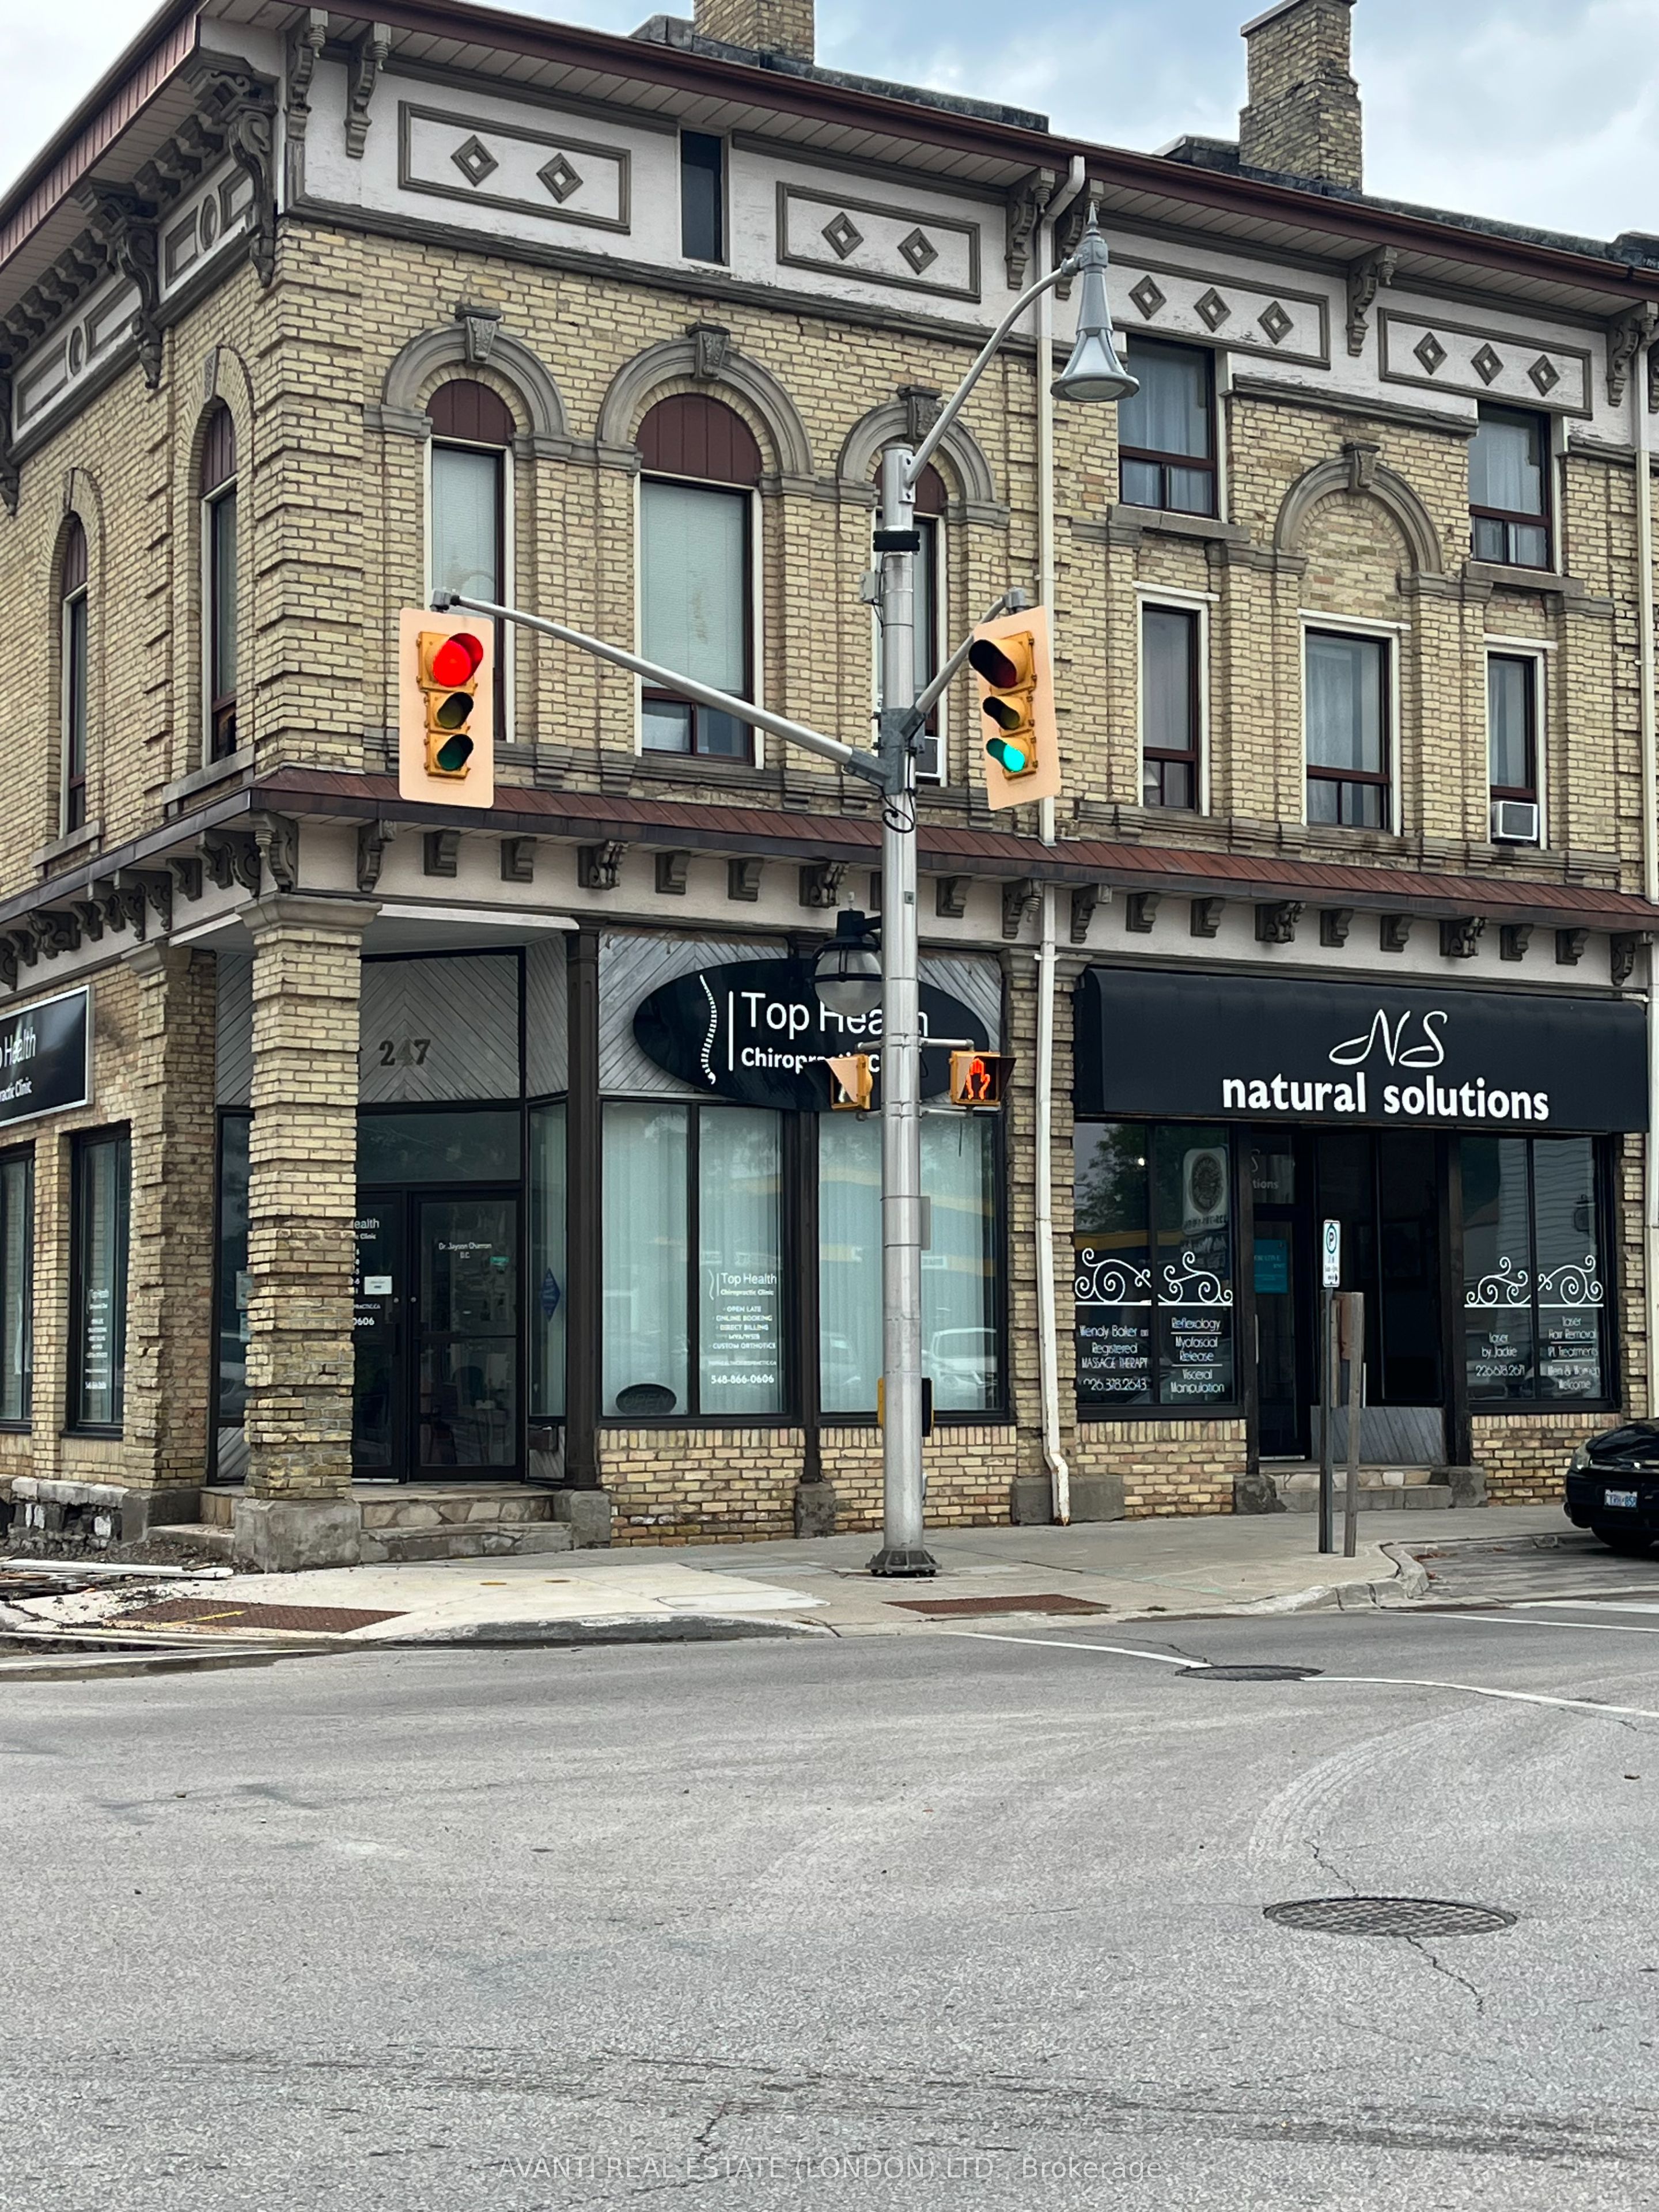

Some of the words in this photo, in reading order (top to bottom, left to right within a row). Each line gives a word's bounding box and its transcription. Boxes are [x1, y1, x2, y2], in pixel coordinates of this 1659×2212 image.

[741, 991, 810, 1040] Top
[820, 1000, 929, 1037] Hea
[1328, 1009, 1448, 1069] NS
[4, 1027, 36, 1067] Health
[379, 1039, 431, 1066] 247
[741, 1047, 881, 1074] Chiropc
[1222, 1071, 1366, 1113] natural
[1384, 1075, 1550, 1121] solutions
[1252, 1179, 1279, 1190] tions
[354, 1218, 380, 1229] ealth
[720, 1272, 741, 1287] Top
[743, 1272, 777, 1285] Health
[720, 1289, 757, 1297] Chiropractic
[1171, 1316, 1221, 1332] Reflexology
[1079, 1324, 1109, 1340] Wendy
[1111, 1324, 1138, 1337] Baker
[1565, 1328, 1597, 1339] Removal
[1092, 1342, 1138, 1357] Registered
[1175, 1336, 1218, 1351] Myofascial
[1179, 1350, 1214, 1361] Release
[1481, 1346, 1492, 1360] by
[1558, 1345, 1599, 1358] Treatments
[1082, 1357, 1116, 1369] MASSAGE
[1119, 1357, 1148, 1369] THERAPY
[1182, 1368, 1213, 1380] Visceral
[1564, 1365, 1571, 1376] &
[710, 1373, 775, 1384] 548-866-0606
[1558, 1379, 1592, 1390] Welcome
[1170, 1381, 1225, 1394] Manipulation
